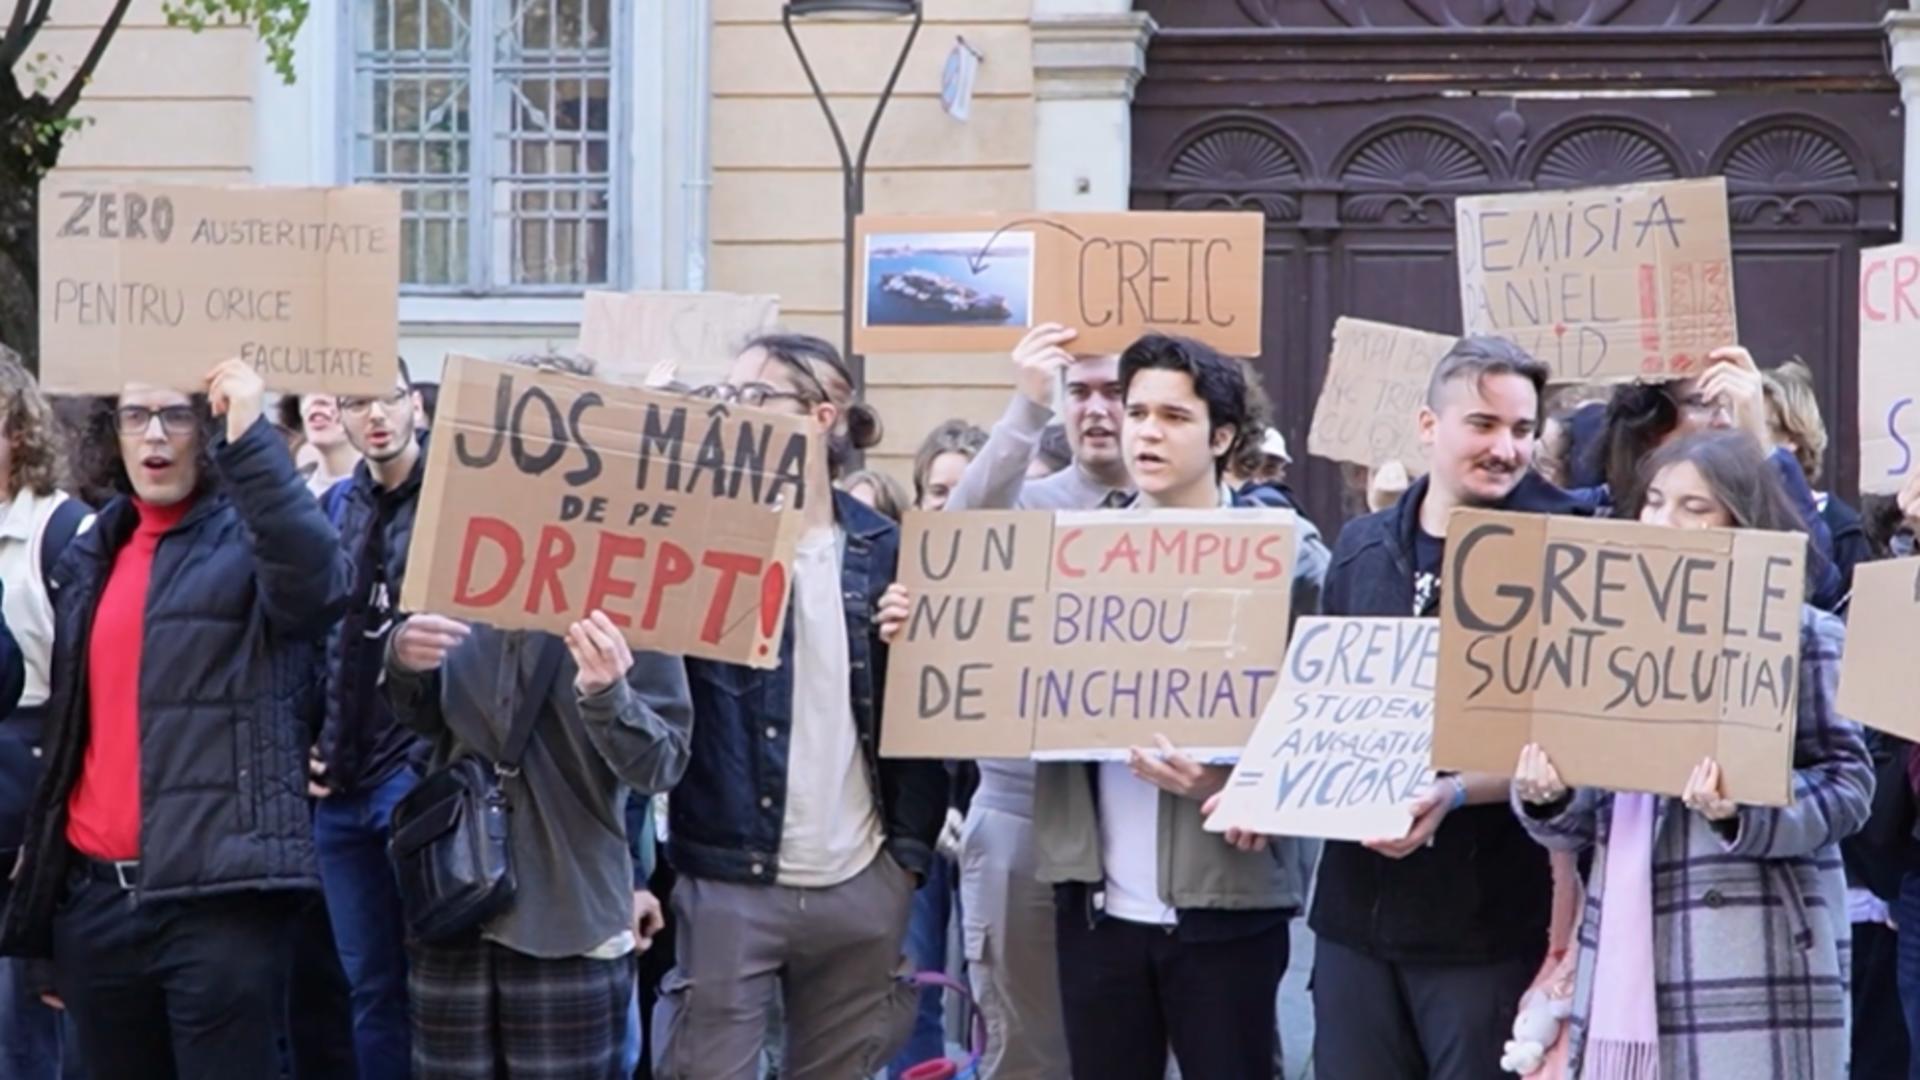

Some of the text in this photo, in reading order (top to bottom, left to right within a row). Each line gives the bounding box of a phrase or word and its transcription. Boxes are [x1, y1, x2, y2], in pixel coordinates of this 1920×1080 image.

[56, 190, 388, 254] ZERO AUSTERITATE
[54, 278, 292, 326] PENTRU ORICE
[1079, 237, 1235, 327] CREIC
[240, 342, 373, 377] FACULTATE
[454, 373, 808, 510] JOS MÂNA
[559, 495, 676, 527] DE PE
[920, 523, 1282, 580] UN CAMPUS
[453, 516, 785, 656] DREPT!
[1453, 523, 1792, 642] GREVELE
[907, 593, 1189, 645] NU E BIROU
[918, 663, 1276, 720] DE INCHIRIAT
[1465, 628, 1605, 700] SUNT
[1287, 692, 1434, 725] STUDEN
[1275, 754, 1430, 811] VICTORIE
